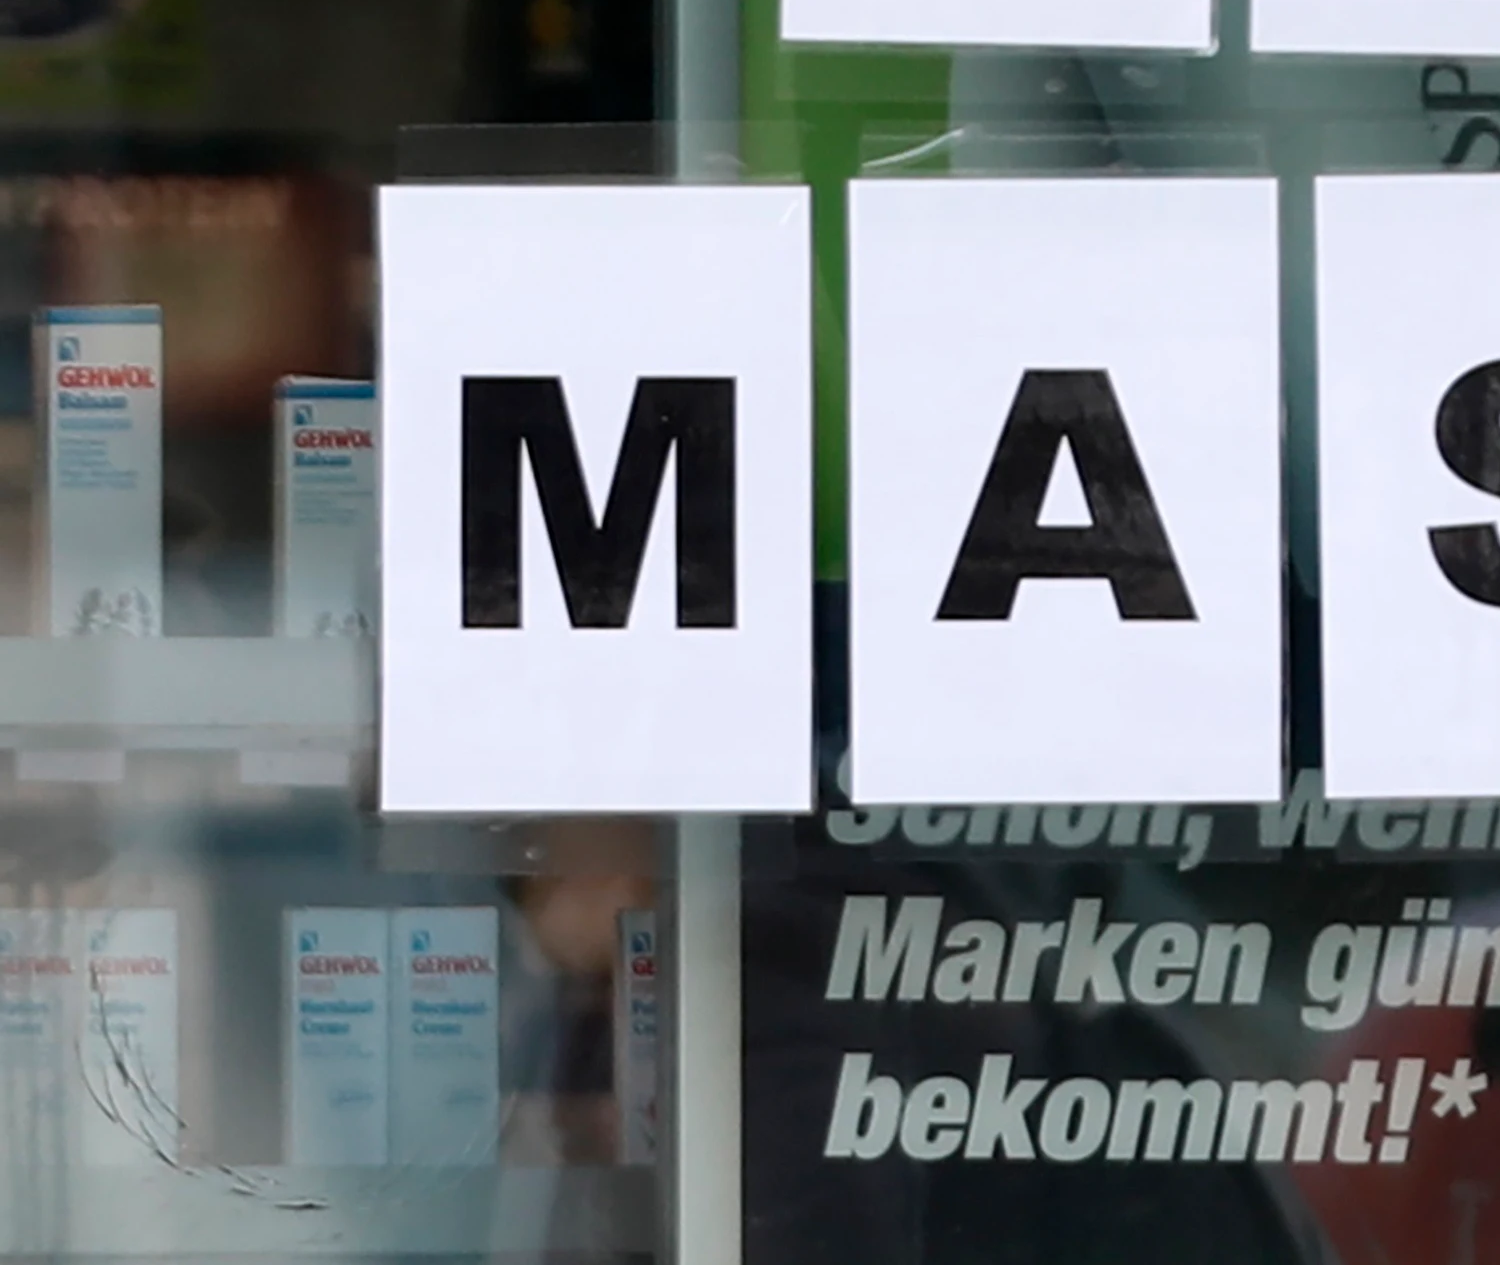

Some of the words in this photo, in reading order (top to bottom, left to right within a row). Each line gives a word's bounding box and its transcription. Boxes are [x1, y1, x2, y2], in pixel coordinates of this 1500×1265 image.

[58, 365, 155, 388] GEHWOL
[826, 897, 1271, 1006] Marken
[299, 956, 380, 975] GEHWOL
[412, 956, 495, 975] GEHWOL
